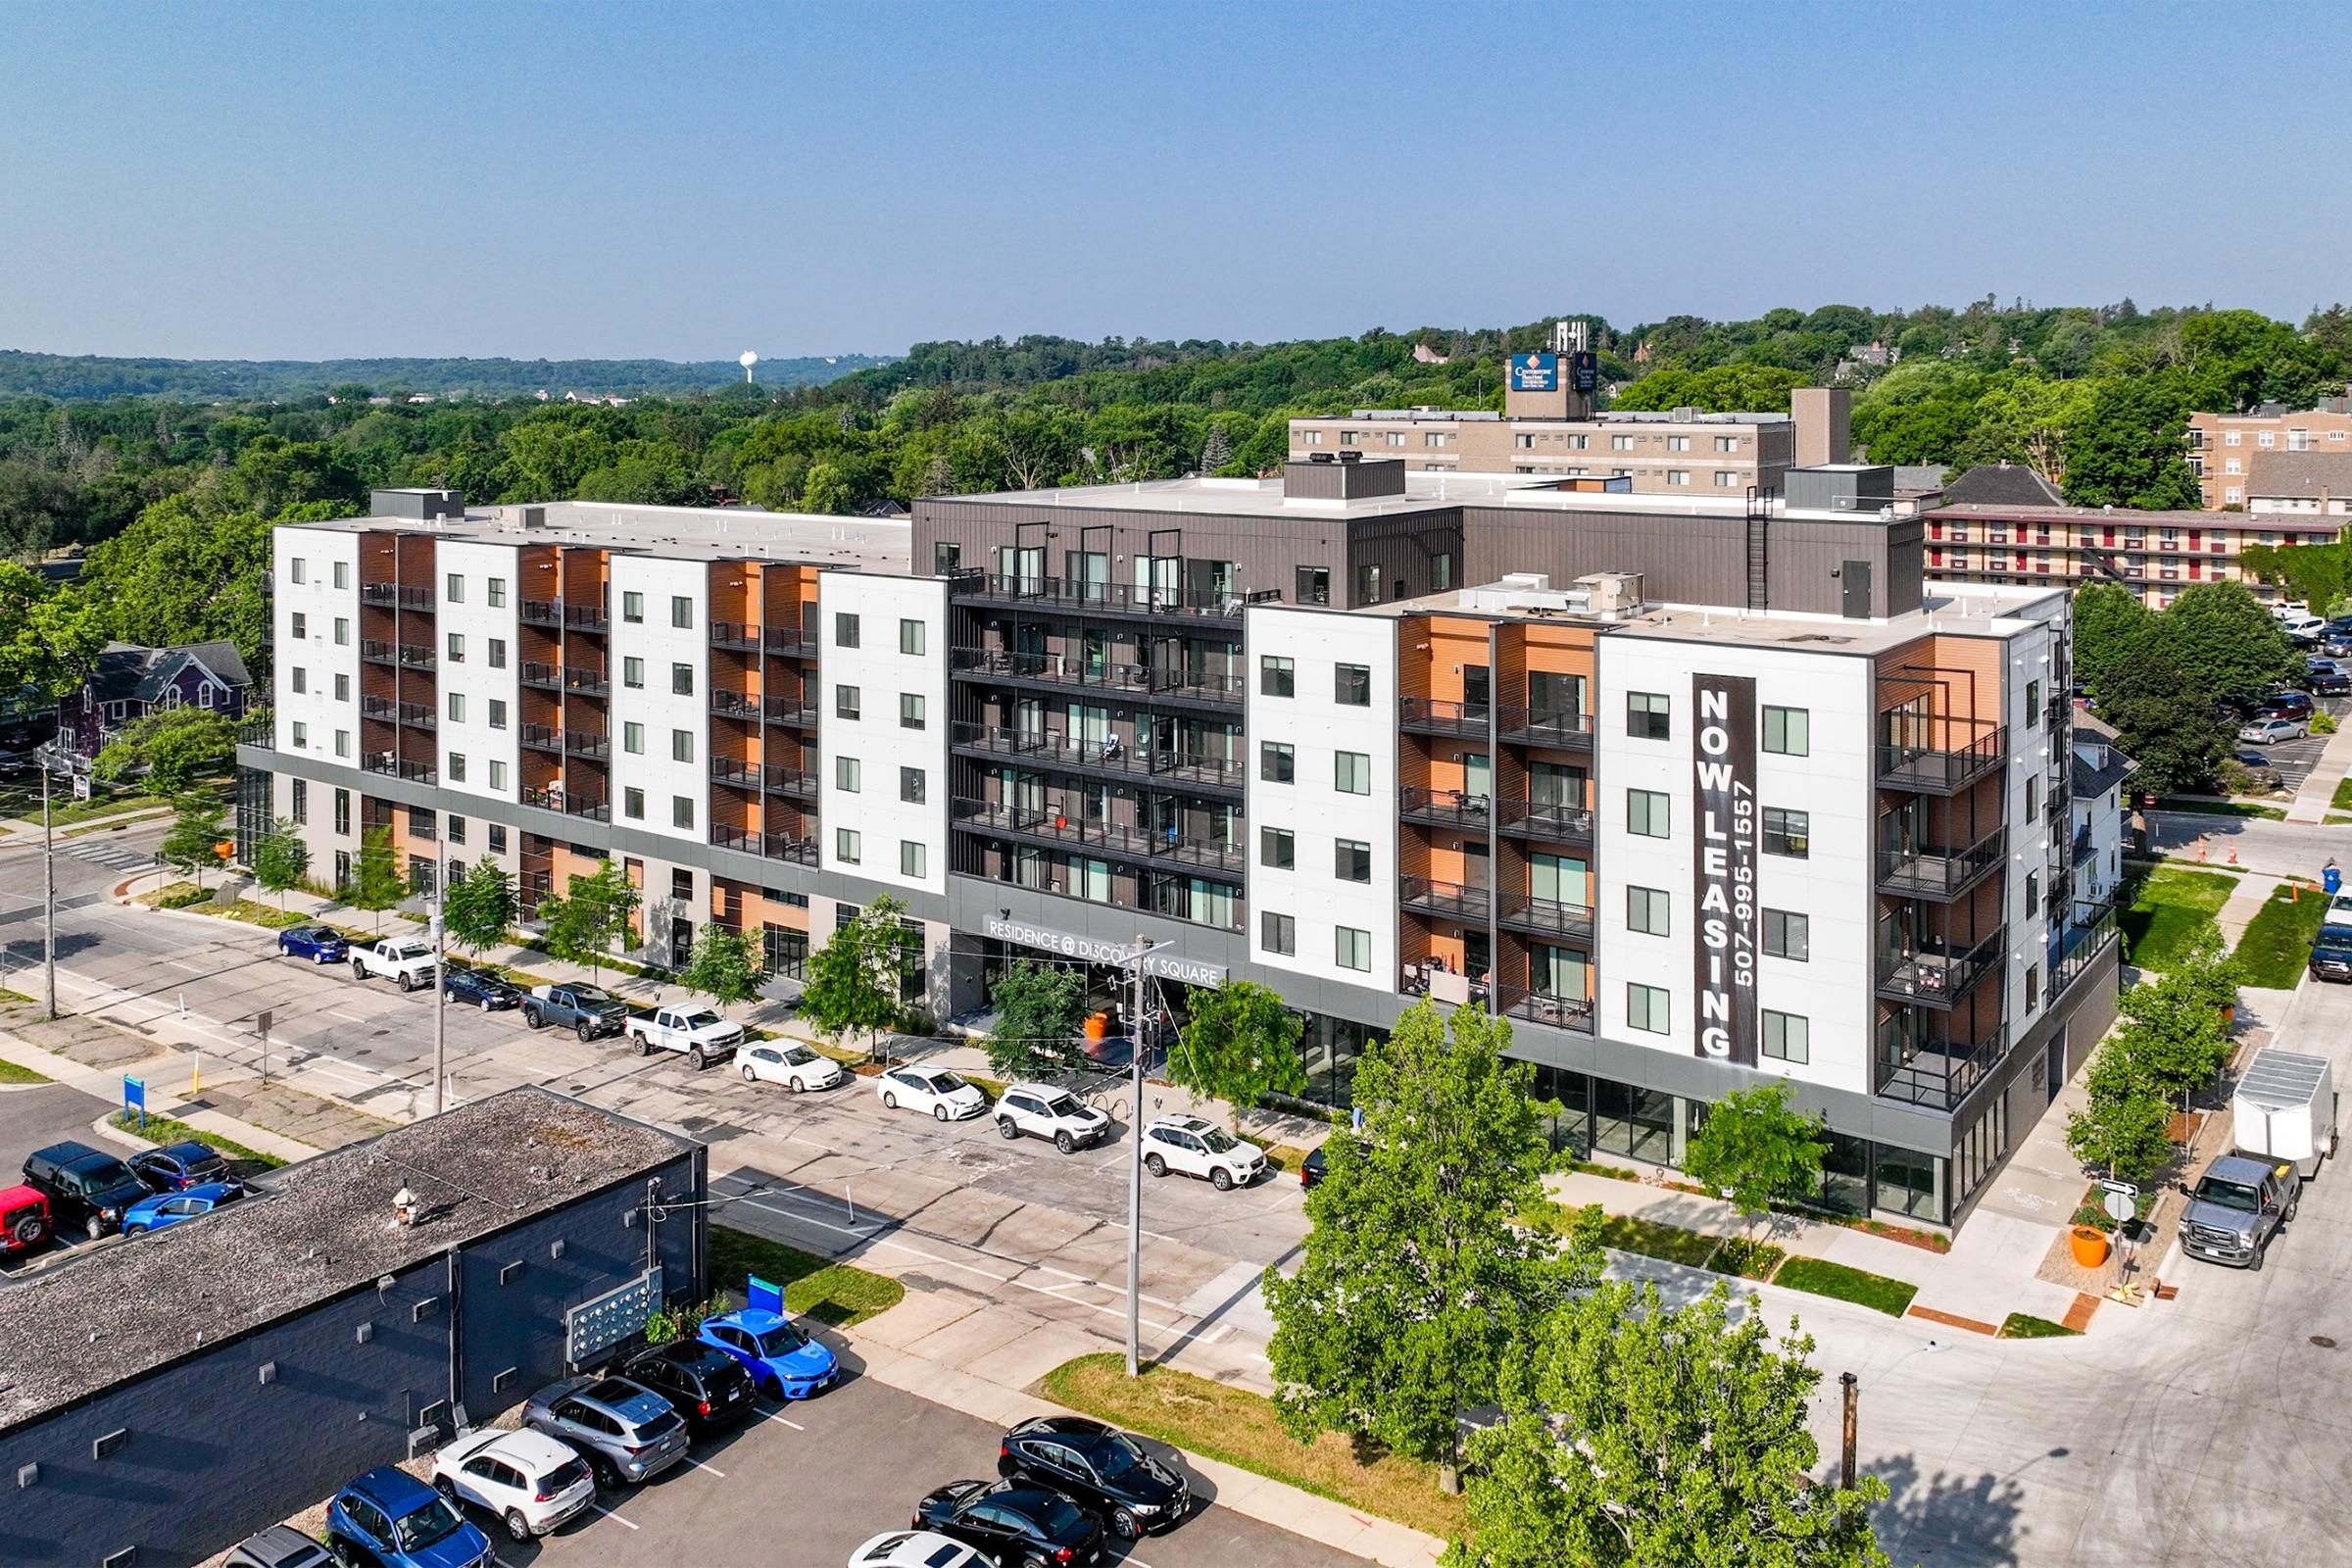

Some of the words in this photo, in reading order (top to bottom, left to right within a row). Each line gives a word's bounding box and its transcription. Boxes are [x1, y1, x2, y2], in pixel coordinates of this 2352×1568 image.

[1696, 690, 1733, 792] NOW
[990, 921, 1058, 950] RESIDENCE
[1061, 936, 1075, 956] @
[1160, 959, 1217, 986] SQUARE
[1701, 810, 1730, 1056] LEASING
[1734, 780, 1752, 988] 507-995-1557
